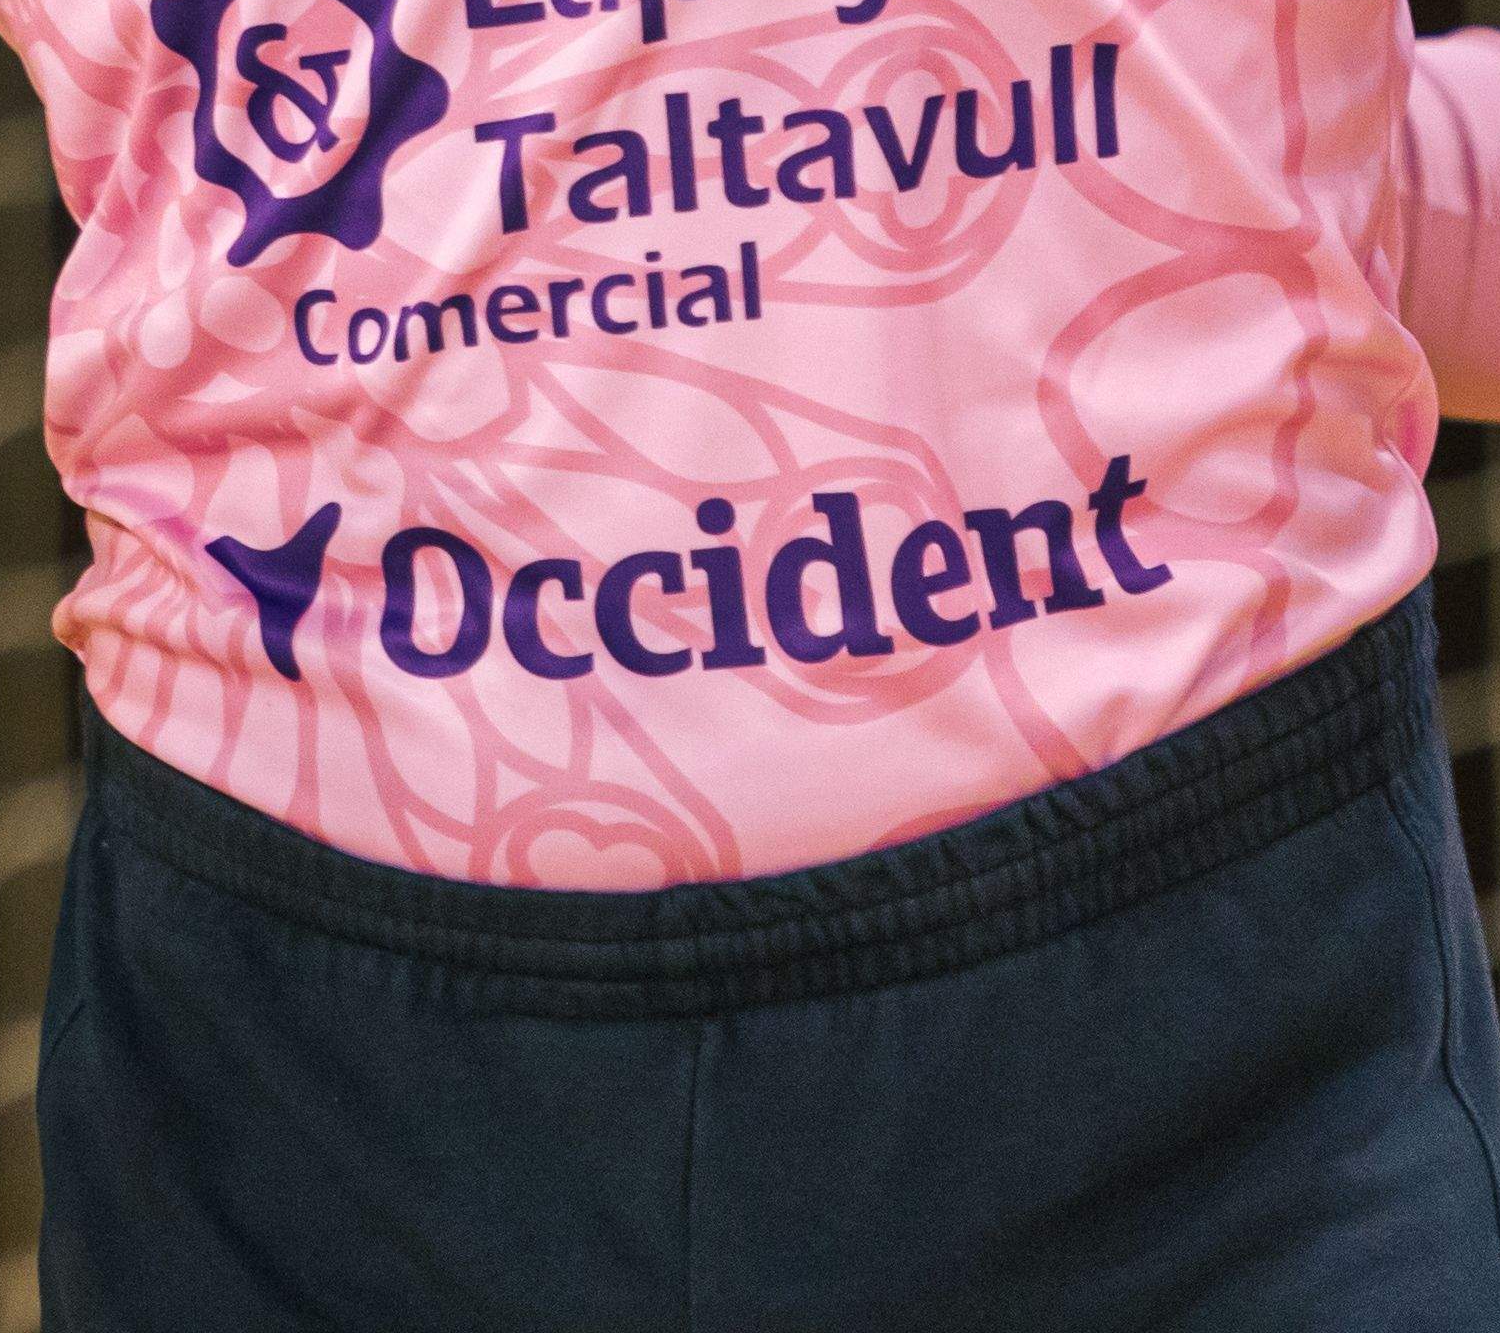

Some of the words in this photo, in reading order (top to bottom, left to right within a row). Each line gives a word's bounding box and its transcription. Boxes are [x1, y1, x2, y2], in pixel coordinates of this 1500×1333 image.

[474, 42, 1121, 234] Taltavull
[294, 243, 763, 367] Comercial
[378, 454, 1173, 681] Occident
